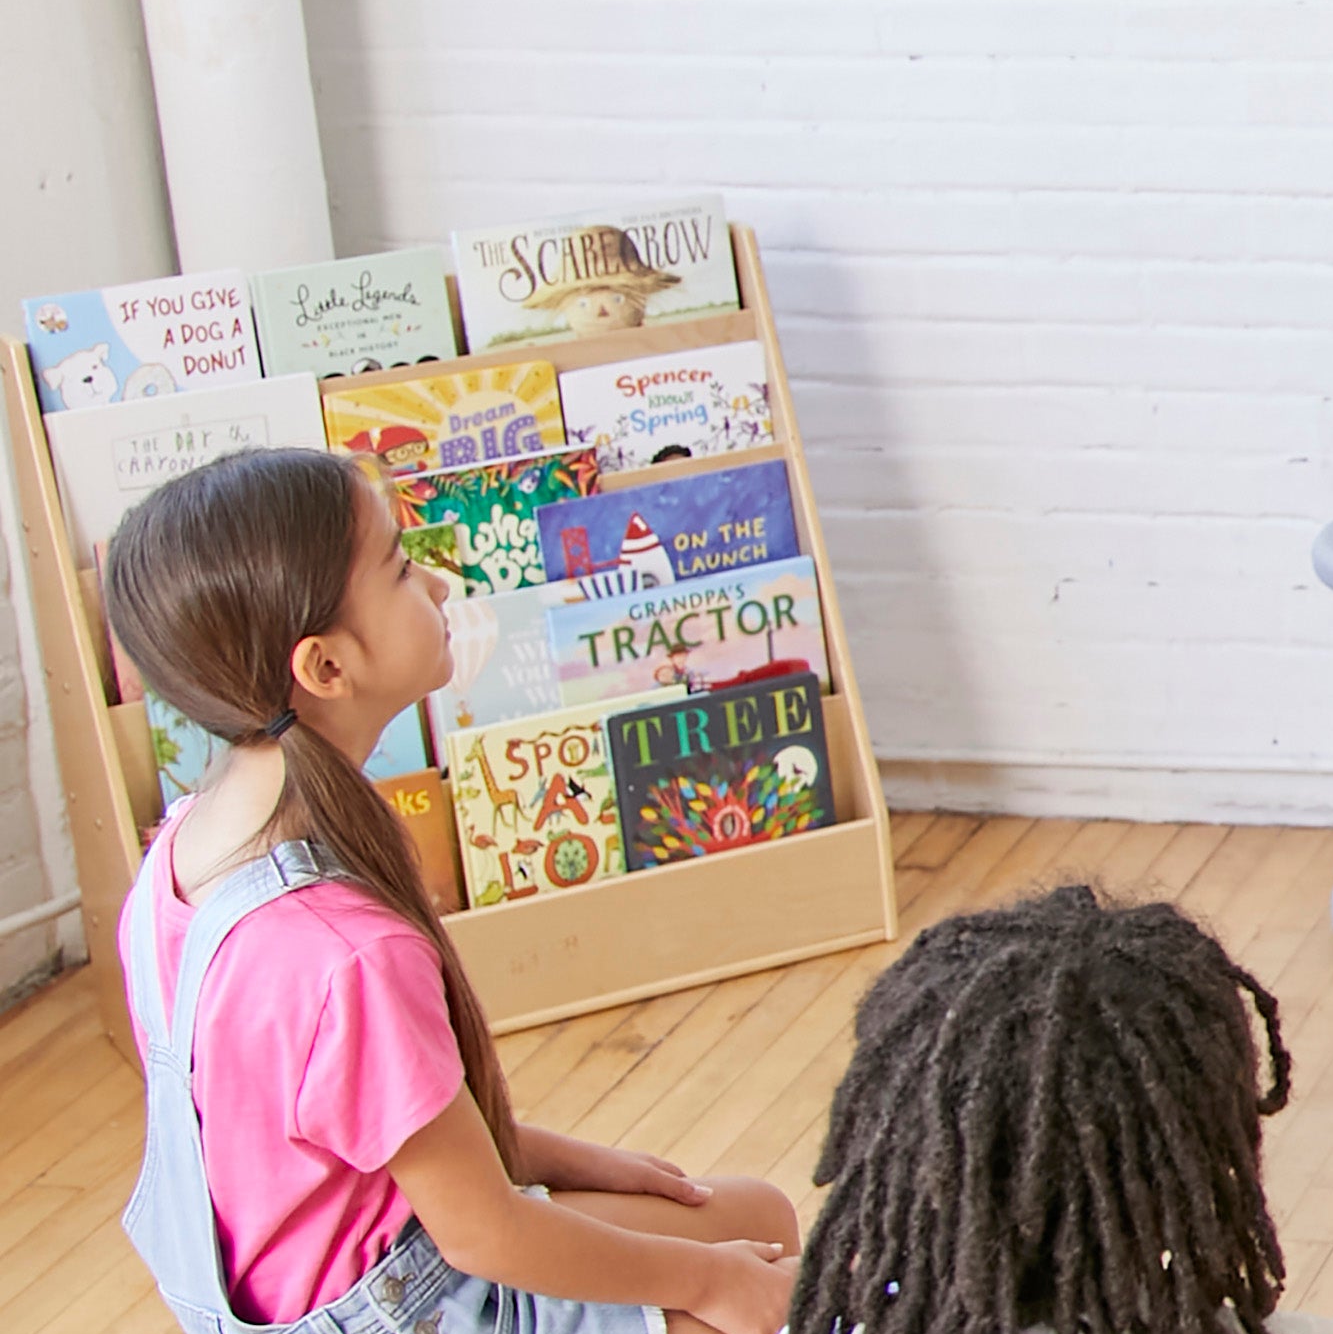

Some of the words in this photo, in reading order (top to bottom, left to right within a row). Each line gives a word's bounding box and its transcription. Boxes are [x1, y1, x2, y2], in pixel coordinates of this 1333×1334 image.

[473, 239, 509, 268] THE
[499, 215, 712, 303] SCARECROW
[119, 299, 140, 323] IF
[146, 294, 184, 317] YOU
[191, 288, 241, 310] GIVE
[290, 283, 350, 327] Little
[351, 270, 421, 311] Legends
[163, 328, 175, 349] A
[181, 321, 223, 344] DOG
[232, 317, 243, 338] A
[183, 345, 246, 376] DONUT
[616, 368, 713, 397] Spencer
[449, 402, 516, 433] Dream
[630, 404, 709, 436] Spring
[176, 430, 213, 452] DAY
[439, 415, 544, 467] BIG
[674, 530, 708, 551] ON
[718, 517, 766, 544] THE
[679, 543, 768, 576] LAUNCH
[629, 583, 746, 621] GRANDPA'S
[578, 594, 798, 668] TRACTOR
[622, 686, 812, 767] TREE
[505, 735, 590, 781] SPO
[498, 832, 600, 901] LO
